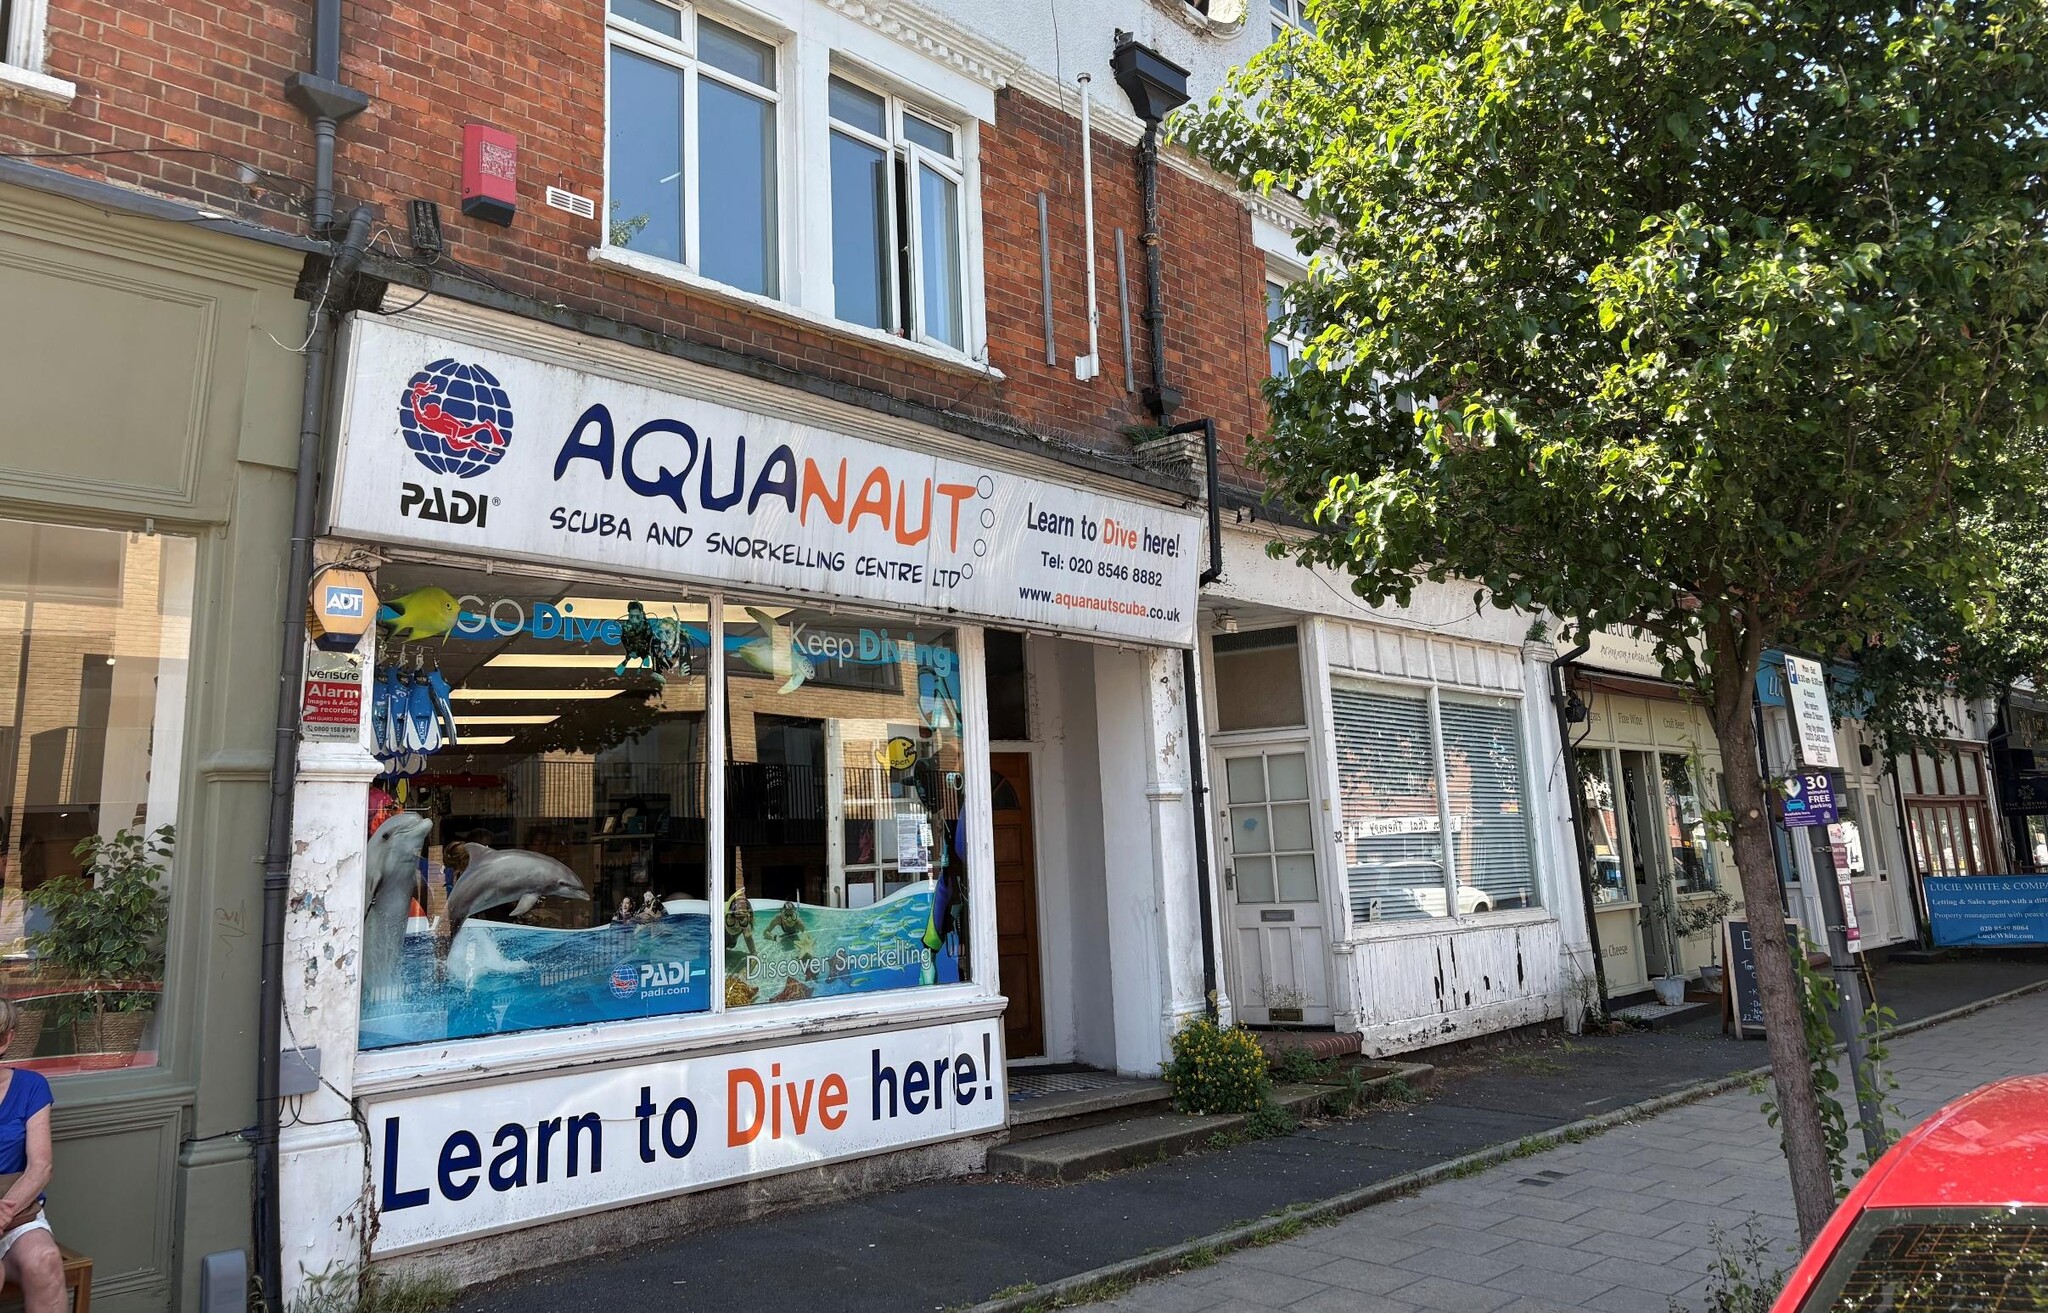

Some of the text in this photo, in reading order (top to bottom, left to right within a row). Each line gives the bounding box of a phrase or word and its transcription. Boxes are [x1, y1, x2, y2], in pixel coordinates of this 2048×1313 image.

[553, 403, 977, 553] AQUANAUT
[1027, 502, 1180, 558] Learn to Dive here!
[549, 506, 961, 588] SCUBA AND SNORKELLING CENTRE LTD
[1041, 551, 1162, 587] Tel: 020 8546 8882
[327, 593, 363, 611] ADT
[1019, 587, 1180, 622] www.aquanautscuba.co.uk
[456, 595, 622, 646] GO Dive
[790, 621, 951, 677] Keep Diving
[309, 670, 360, 680] verisure
[308, 684, 359, 698] Alarm
[320, 706, 358, 716] recording
[890, 757, 910, 767] open
[1805, 775, 1828, 790] 30
[1808, 794, 1831, 803] FREE
[1334, 831, 1343, 843] 32
[1930, 883, 1962, 891] LUCIE
[1963, 882, 2000, 891] WHITE
[2002, 882, 2011, 890] &
[1932, 898, 1957, 906] Letting
[746, 940, 932, 982] Discover Snorkelling
[640, 961, 690, 988] PADI
[640, 986, 690, 999] padi.com
[381, 1032, 993, 1213] Learn to Dive here!
